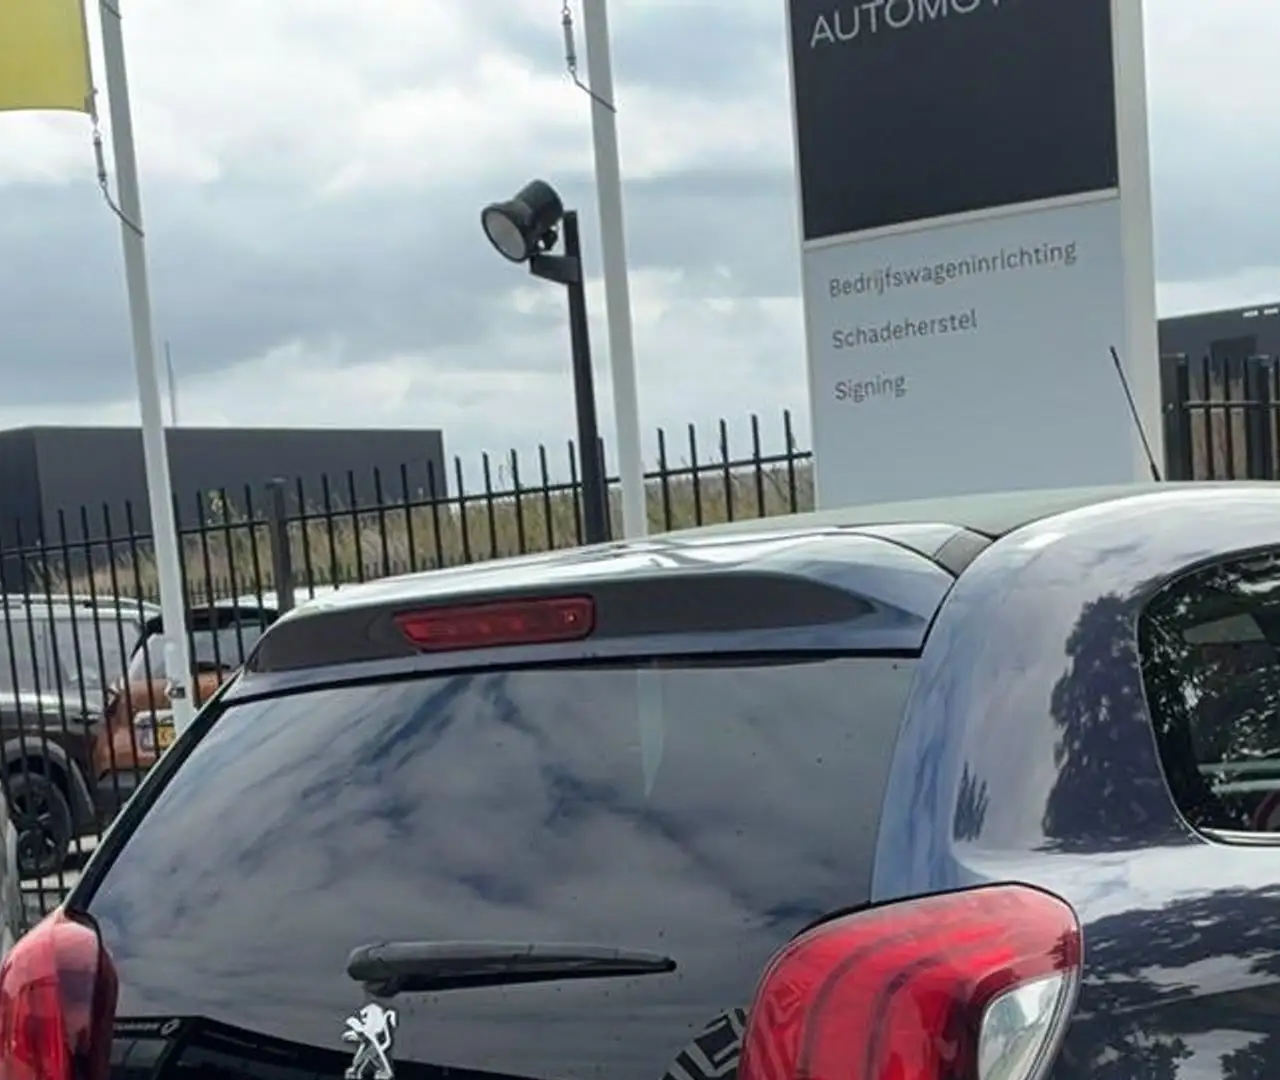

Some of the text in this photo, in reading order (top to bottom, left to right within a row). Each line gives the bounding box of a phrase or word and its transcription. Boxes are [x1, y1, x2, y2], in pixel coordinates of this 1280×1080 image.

[829, 242, 1078, 299] Bedrijfswageninrichting
[832, 309, 978, 350] Schadeherstel
[834, 373, 906, 403] Signing
